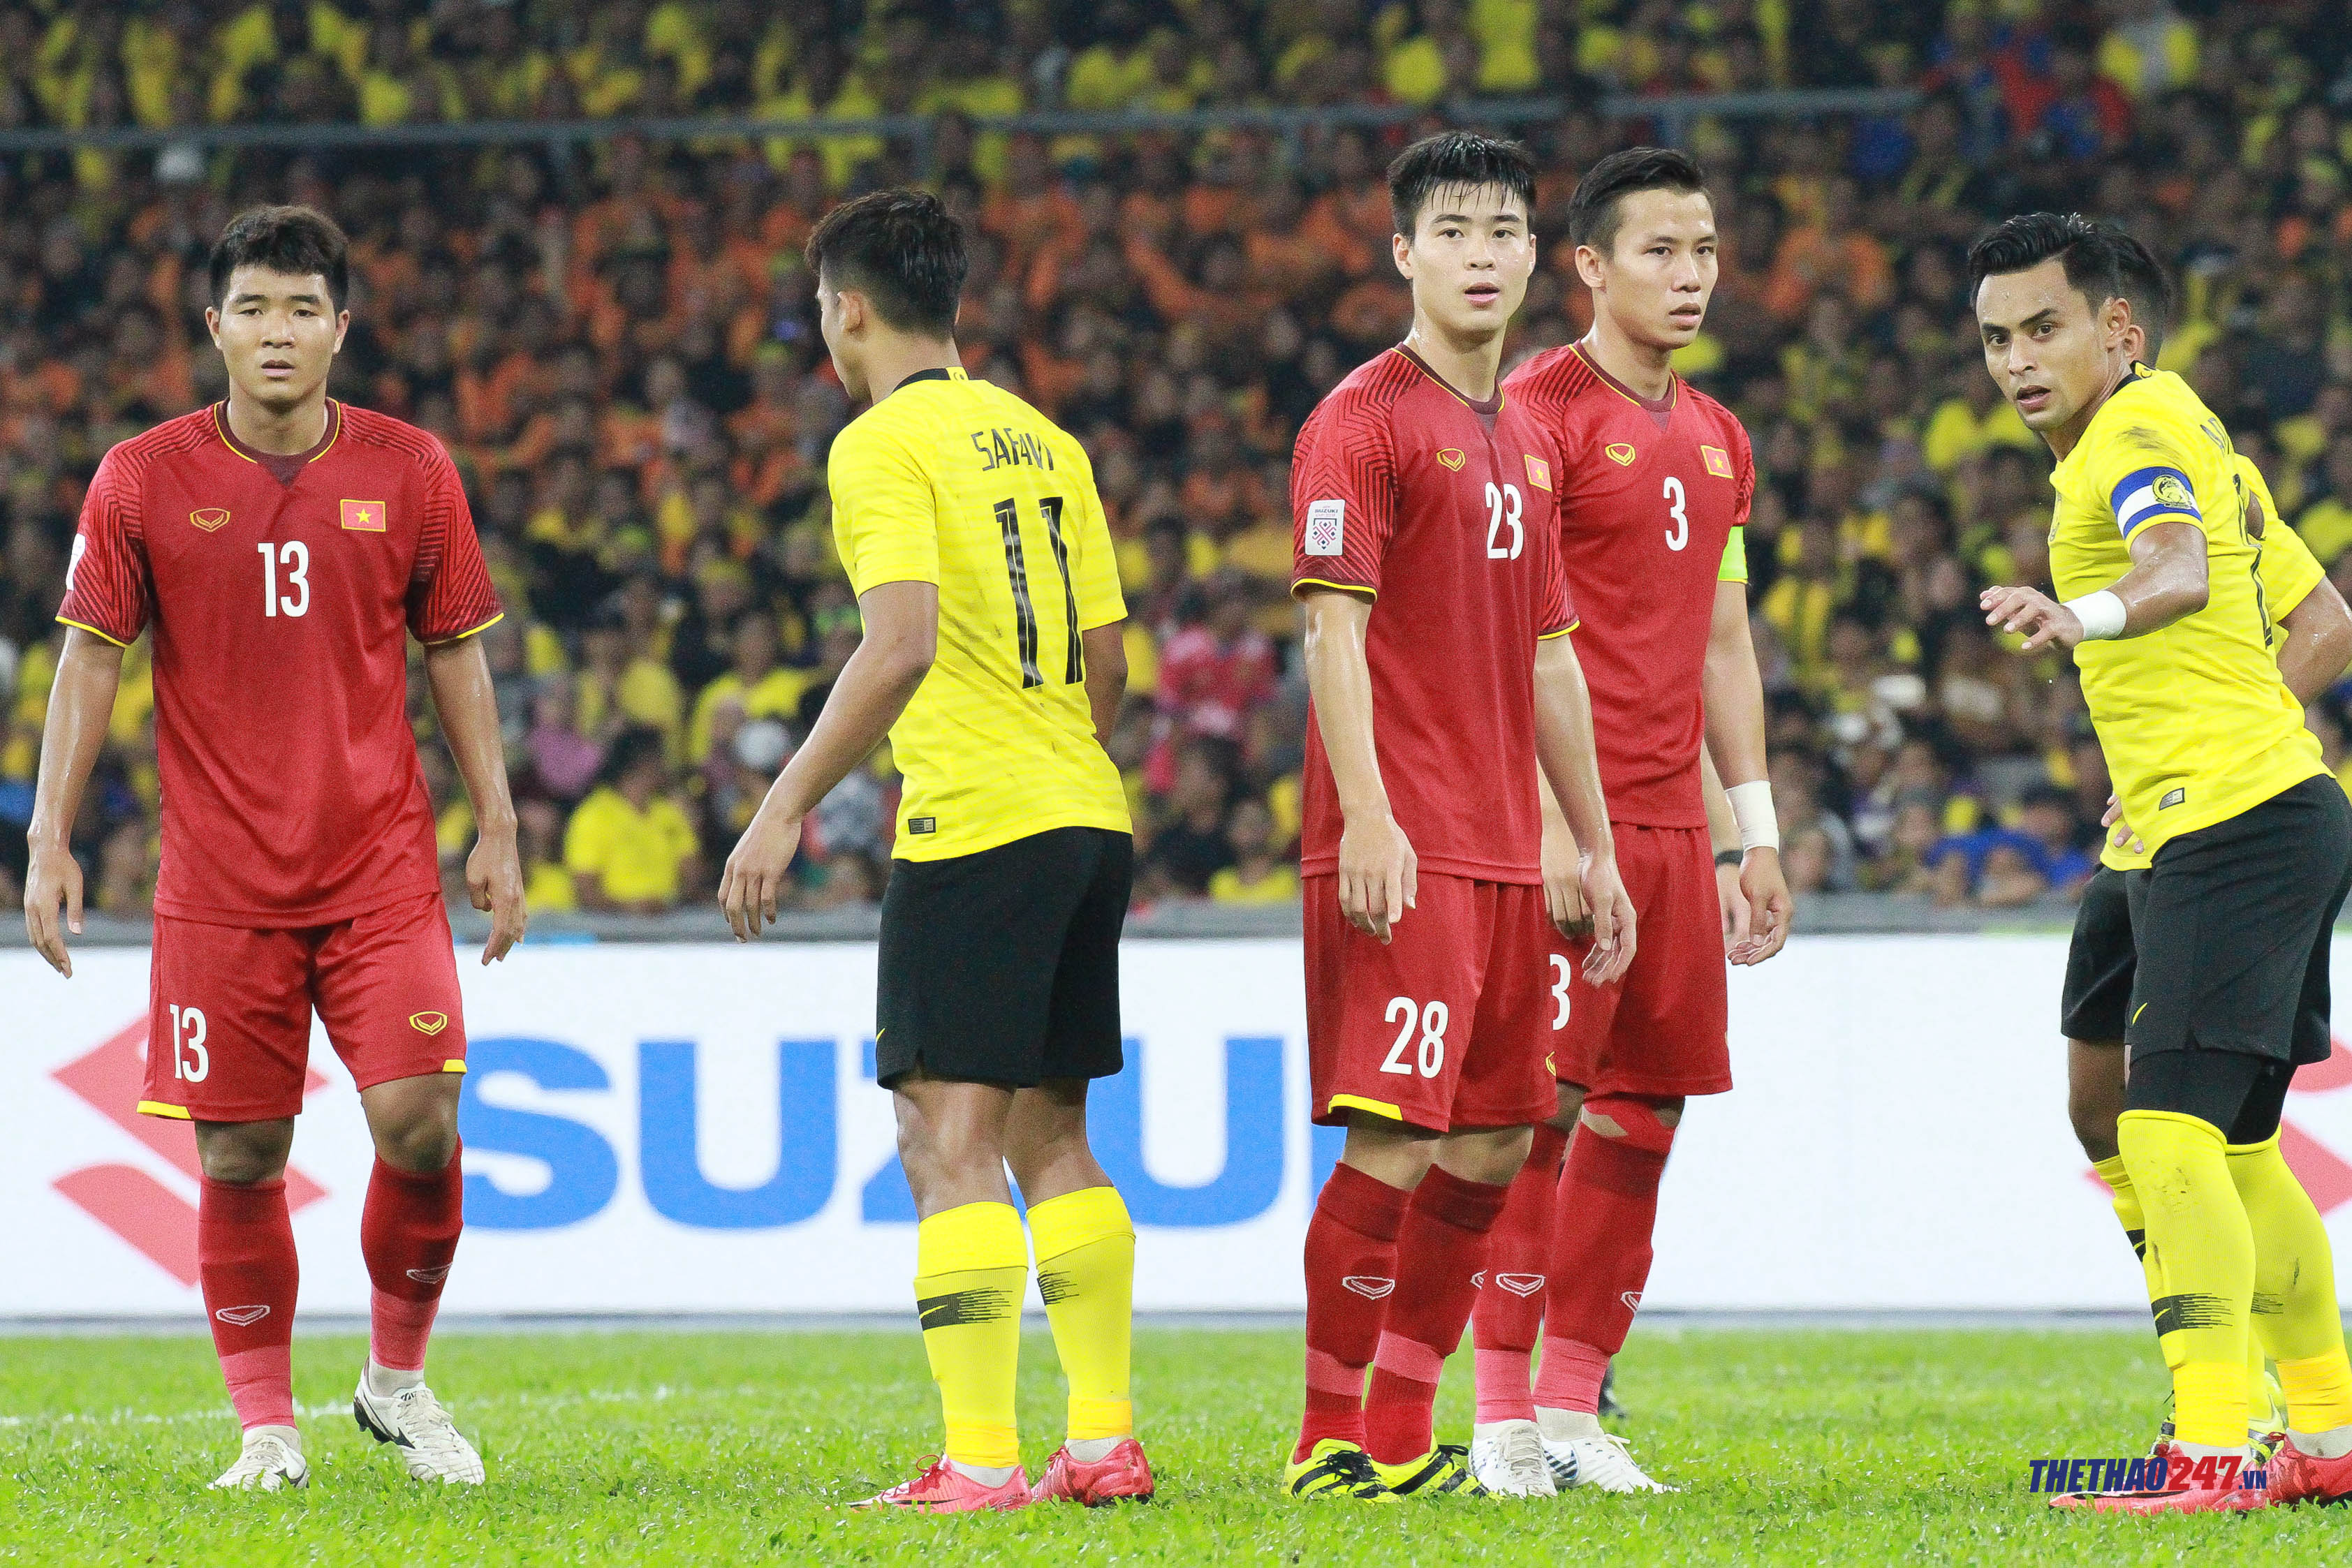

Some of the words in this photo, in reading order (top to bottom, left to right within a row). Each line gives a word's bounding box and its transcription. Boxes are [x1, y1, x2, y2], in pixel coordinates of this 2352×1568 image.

[1663, 476, 1689, 552] 3
[257, 540, 310, 617] 13
[993, 496, 1083, 689] 11
[1549, 954, 1571, 1030] 3
[169, 1003, 210, 1083] 13
[1379, 996, 1449, 1079] 28
